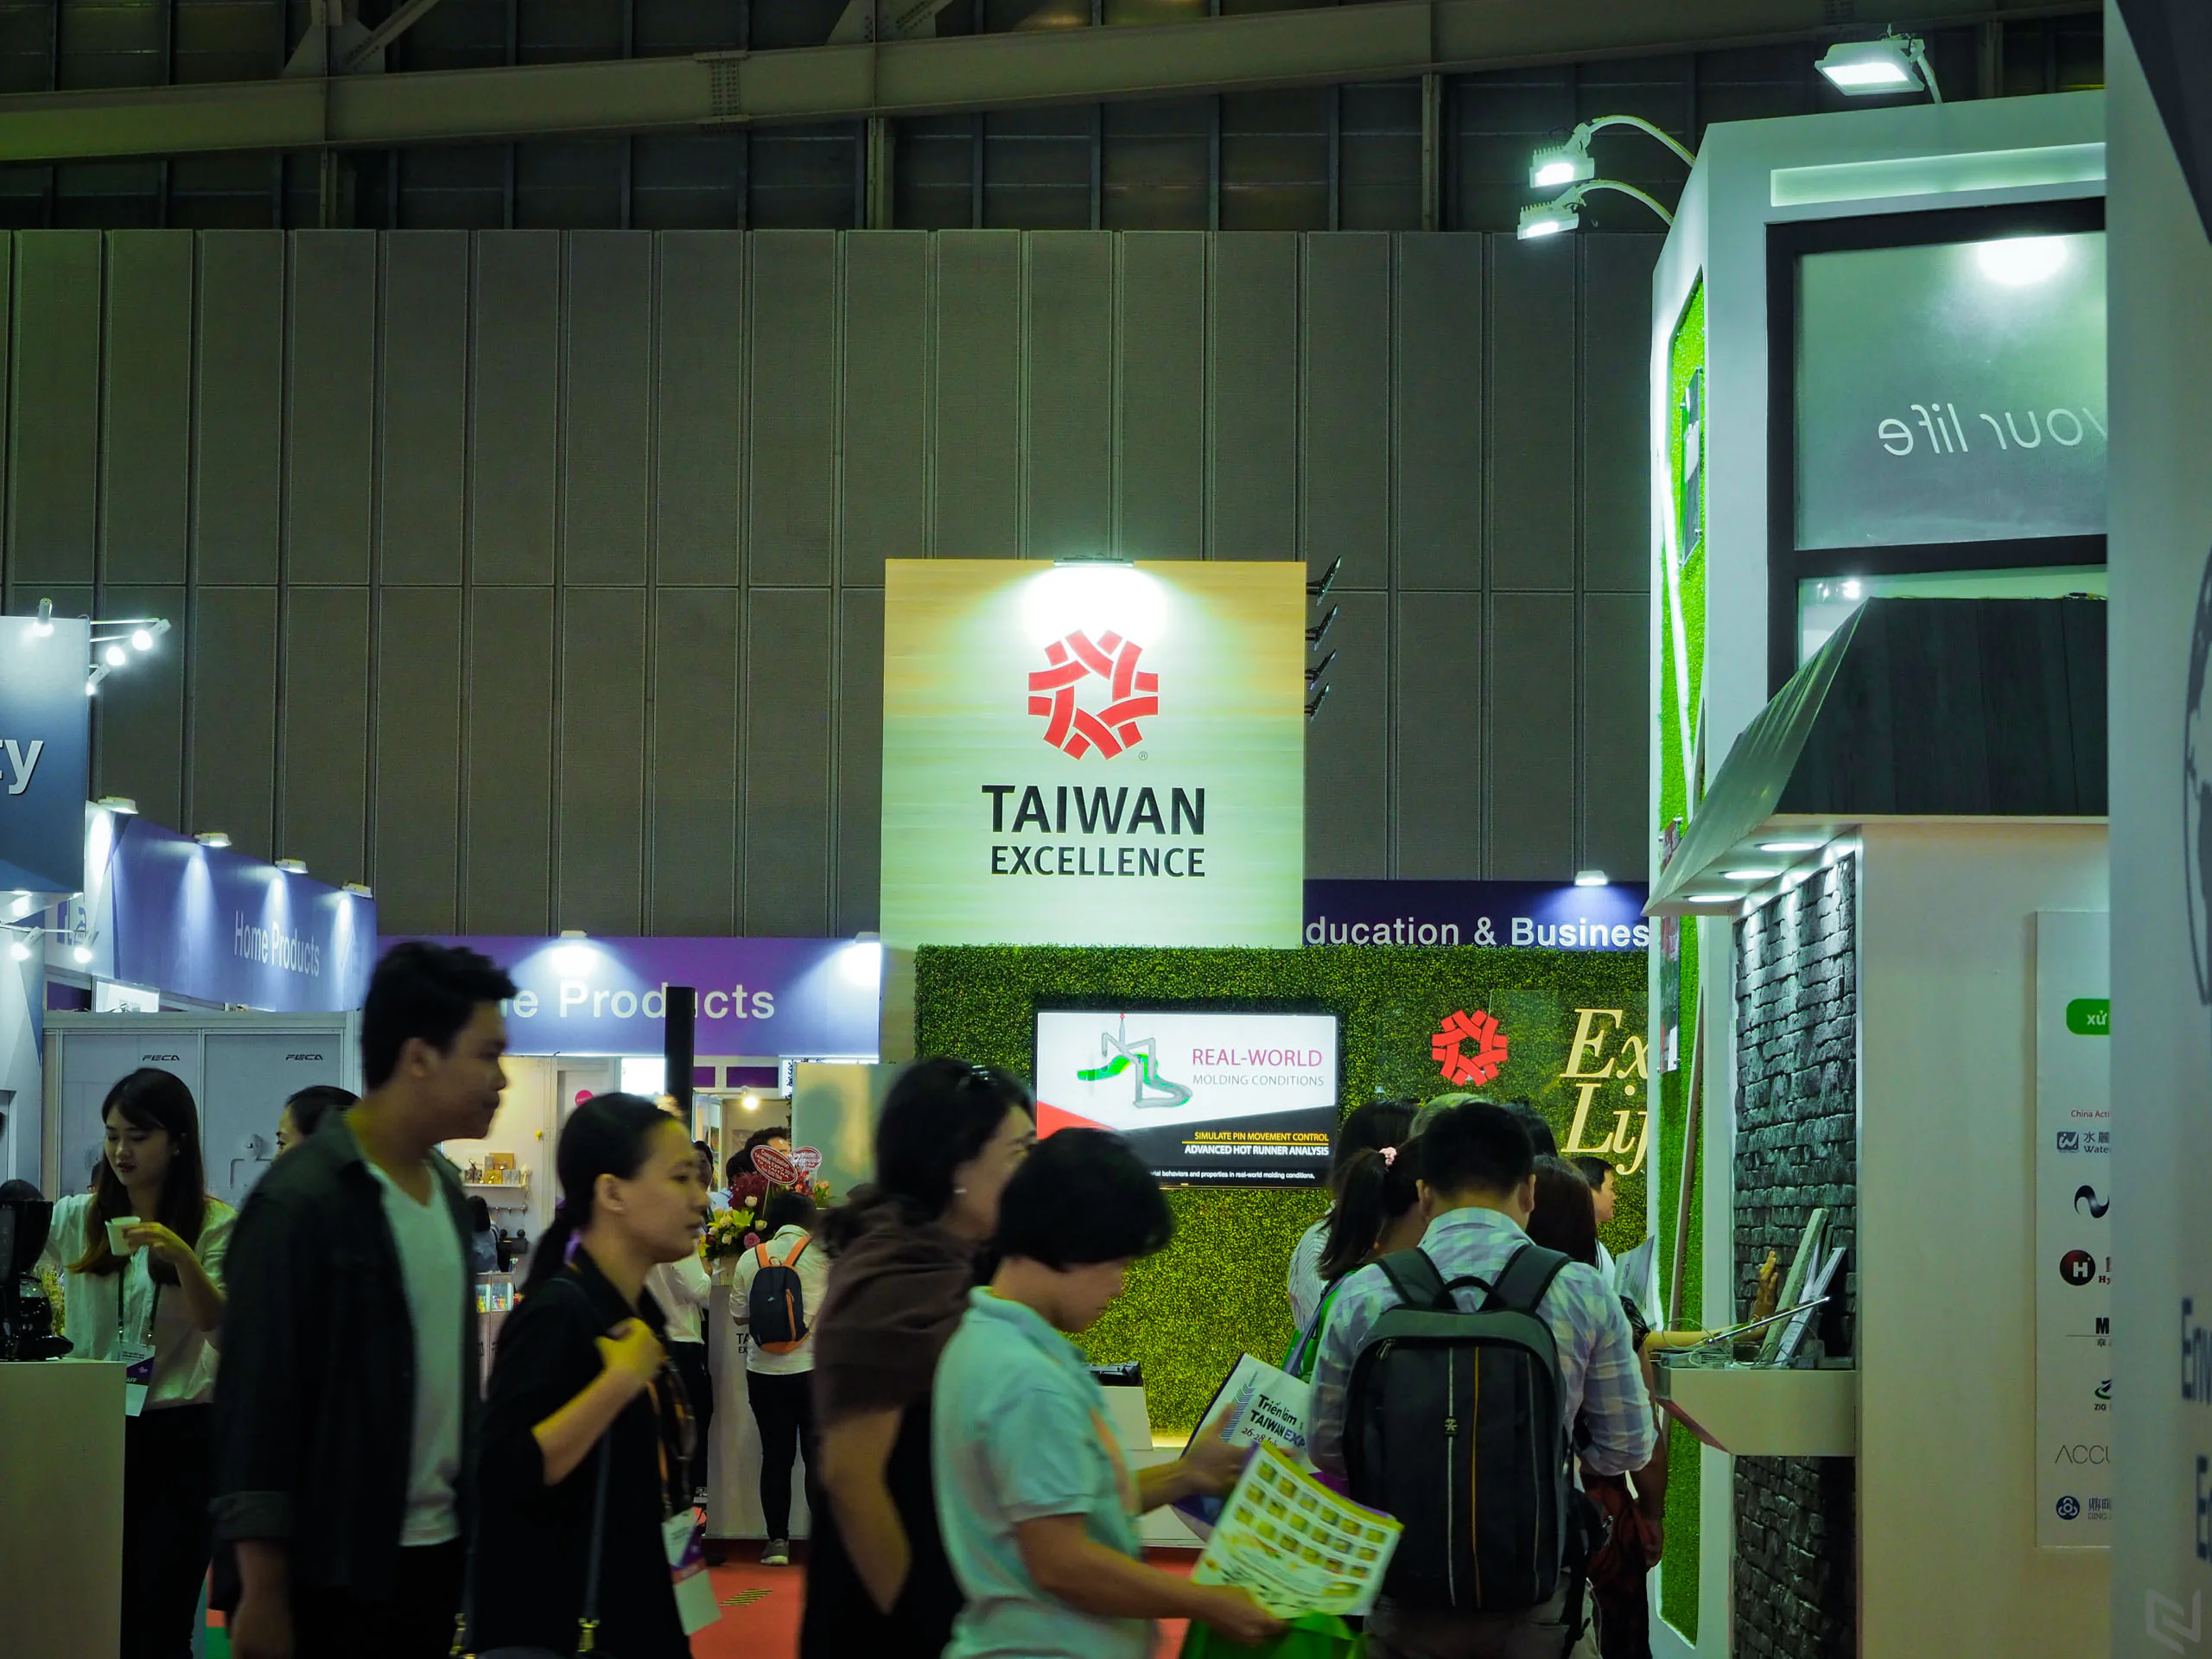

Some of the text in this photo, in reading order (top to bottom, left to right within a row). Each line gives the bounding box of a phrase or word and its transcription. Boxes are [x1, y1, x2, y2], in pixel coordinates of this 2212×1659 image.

[0, 739, 44, 795] y
[981, 785, 1205, 836] TAIWAN
[991, 845, 1205, 878] EXCELLENCE
[234, 910, 320, 977] Home Products
[1473, 917, 1497, 945] &
[559, 981, 775, 1019] Prodcts
[1192, 1048, 1323, 1067] REAL-WORLD
[1192, 1075, 1325, 1086] MOLDING CONDITIONS
[2070, 1109, 2093, 1118] China
[1185, 1145, 1329, 1156] ADVANCED HOT RUNNER ANALYSIS
[1194, 1131, 1329, 1142] SIMULATE PIN MOVEMENT CONTROL
[2084, 1145, 2111, 1154] Wate
[1250, 1409, 1286, 1437] TAIWAN
